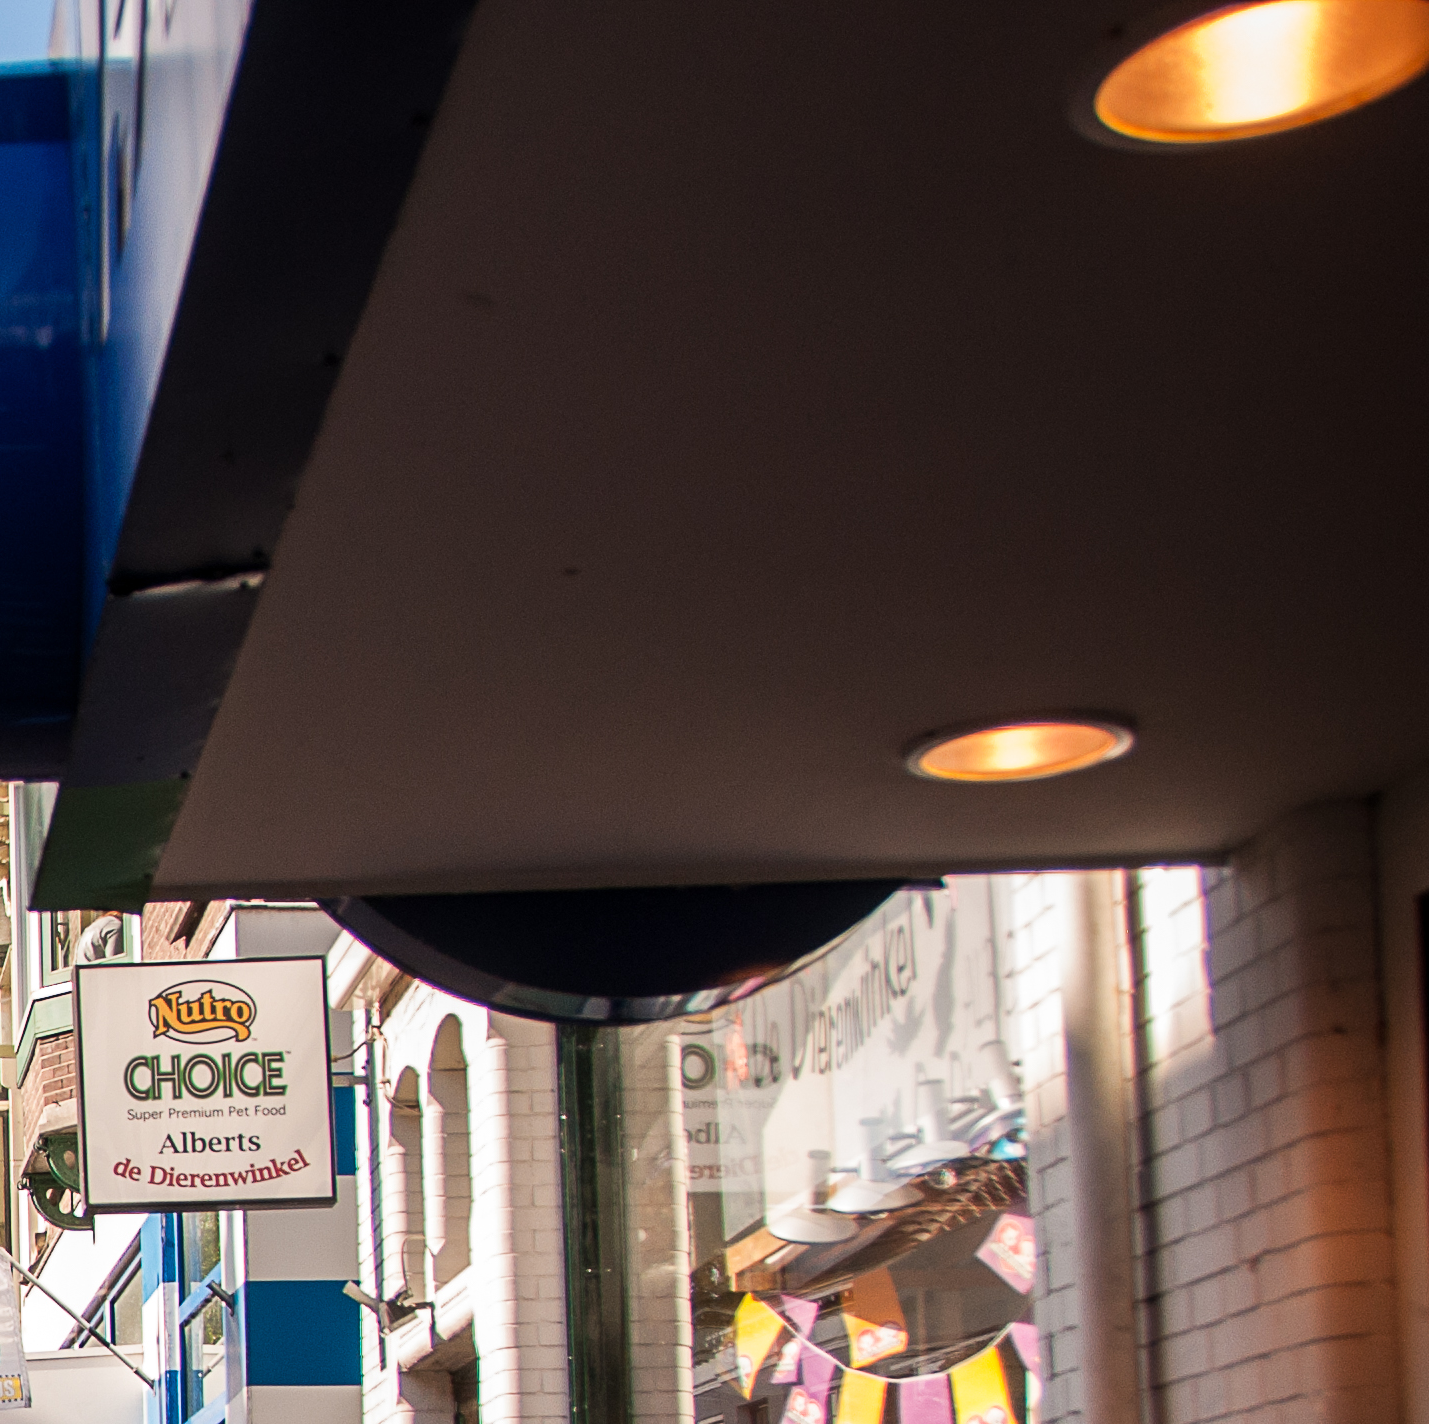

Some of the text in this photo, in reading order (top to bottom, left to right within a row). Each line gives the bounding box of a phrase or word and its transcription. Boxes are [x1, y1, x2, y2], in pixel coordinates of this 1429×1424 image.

[149, 988, 251, 1042] Nutro
[124, 1051, 288, 1101] CHOICE
[127, 1104, 286, 1122] Super Premium Pet Food
[159, 1132, 262, 1154] Alberts
[113, 1149, 311, 1188] de Dierenwinkel
